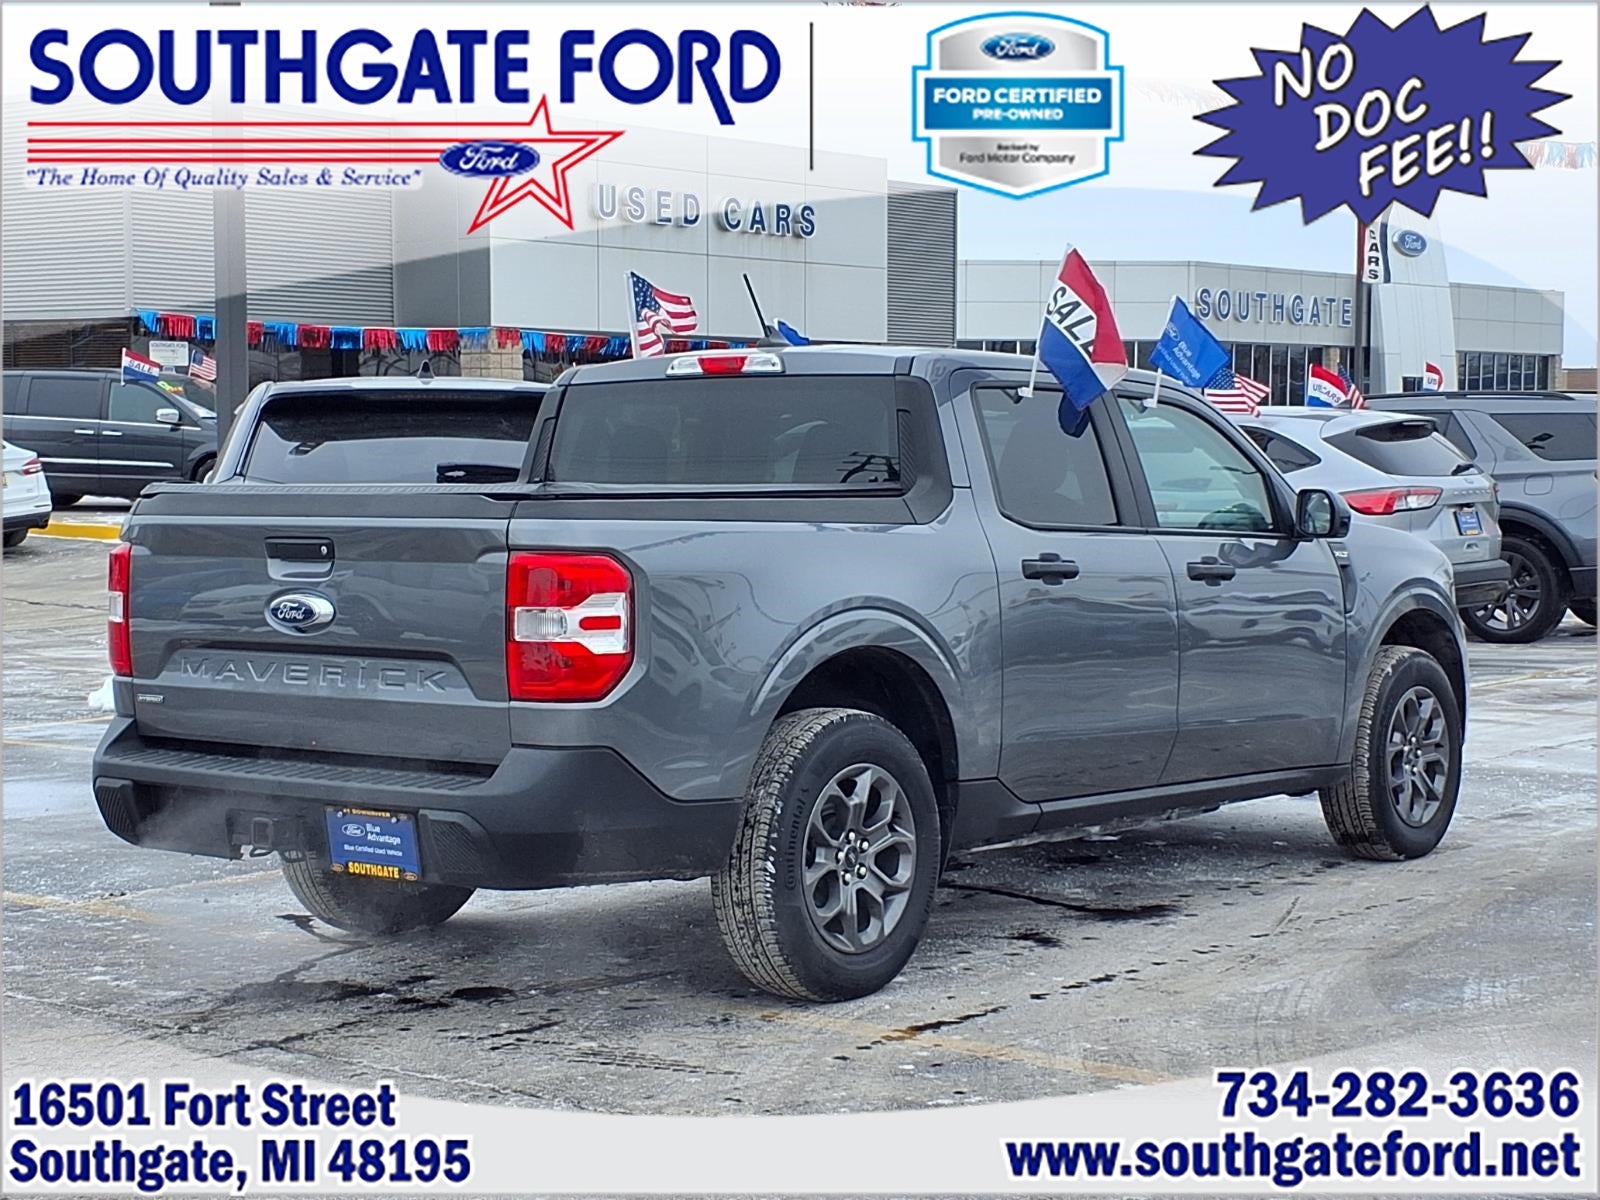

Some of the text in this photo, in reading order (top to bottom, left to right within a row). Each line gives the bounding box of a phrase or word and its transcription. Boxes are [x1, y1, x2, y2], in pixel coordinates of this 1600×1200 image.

[592, 184, 816, 239] USED CARS
[1404, 234, 1422, 250] Ford
[1196, 287, 1353, 328] SOUTHGATE
[128, 359, 153, 375] SALE
[277, 601, 306, 620] Ford
[180, 655, 449, 693] MAVERICK
[366, 823, 381, 833] Blue
[367, 833, 401, 845] Advantage
[348, 862, 400, 878] SOUTHGATE
